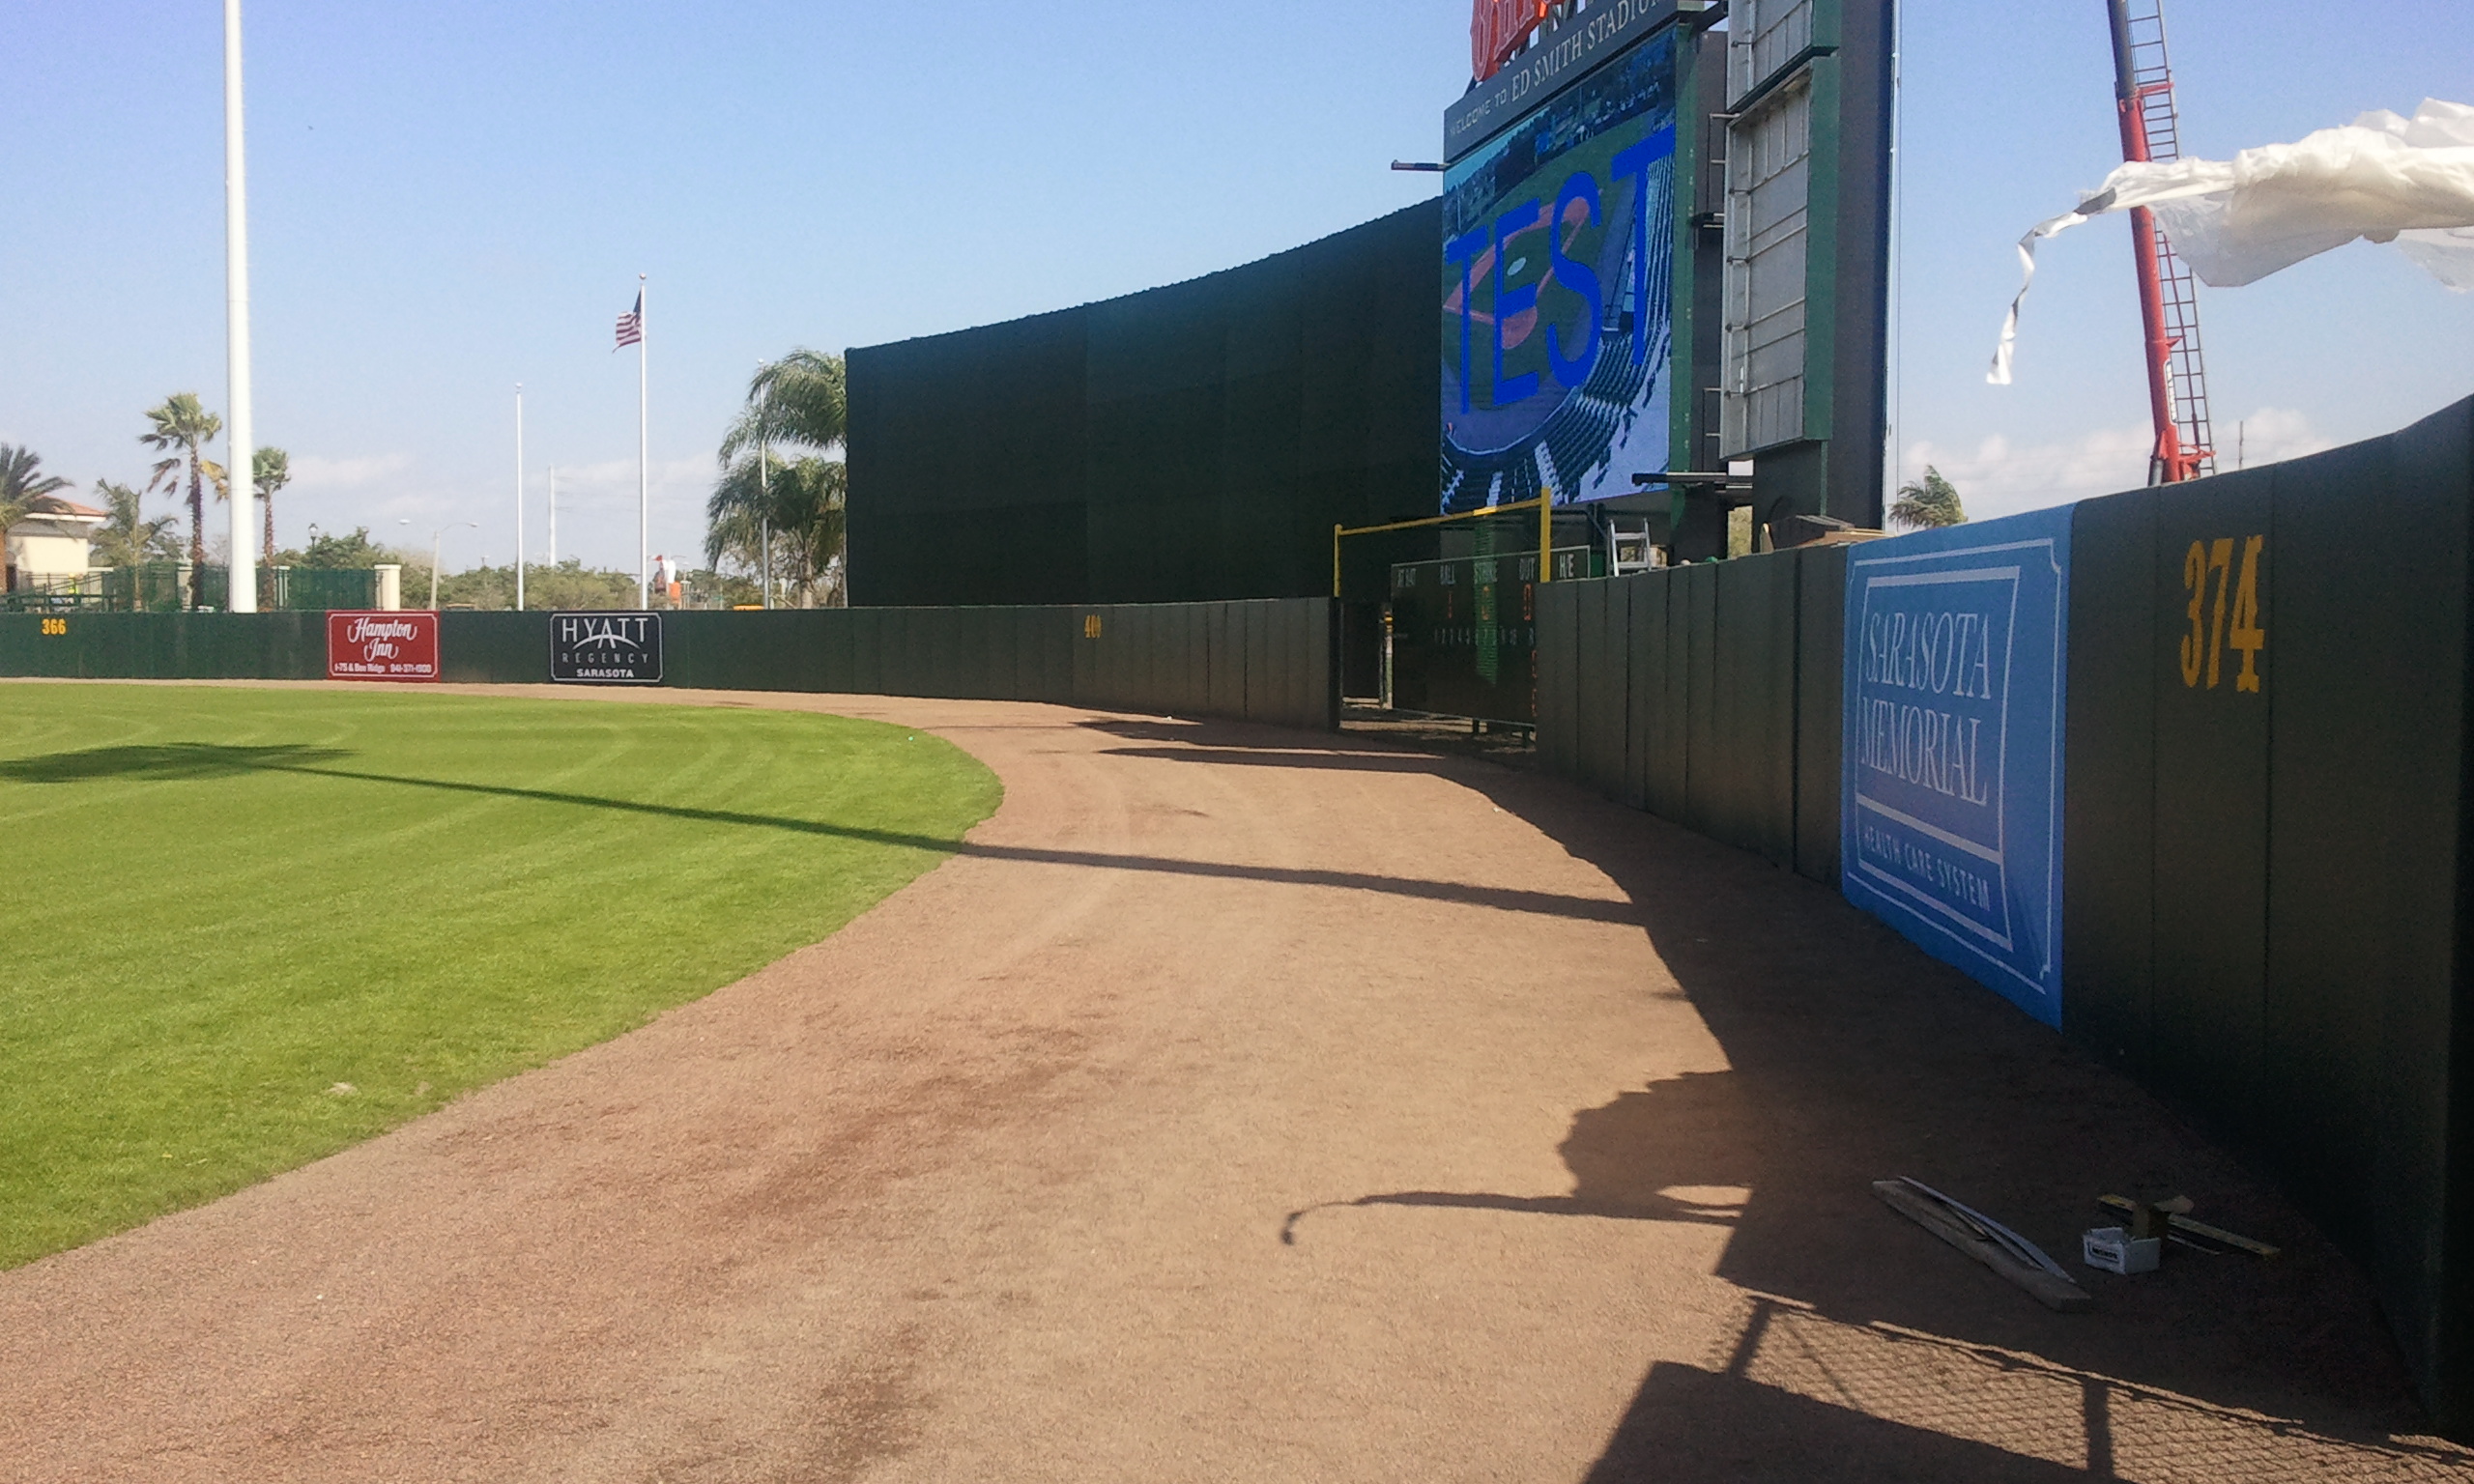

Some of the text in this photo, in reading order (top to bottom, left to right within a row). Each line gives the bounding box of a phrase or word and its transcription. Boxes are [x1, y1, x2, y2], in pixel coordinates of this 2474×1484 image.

[1450, 99, 1492, 135] WELCOME
[1494, 88, 1507, 107] TO
[1511, 68, 1530, 102] ED
[1534, 30, 1583, 86] SMITH
[1445, 123, 1677, 416] TEST
[42, 618, 67, 635] 366
[347, 616, 417, 643] Hampton
[561, 617, 648, 648] HYATT
[2180, 534, 2265, 694] 374
[363, 638, 399, 663] Inn
[561, 653, 648, 664] REGENCY
[576, 669, 635, 678] SARASOTA
[1866, 612, 1991, 700] SARASOTA
[1861, 697, 1987, 807] MEMORIAL
[1864, 826, 1991, 912] HEALTH CARE SYSTEM
